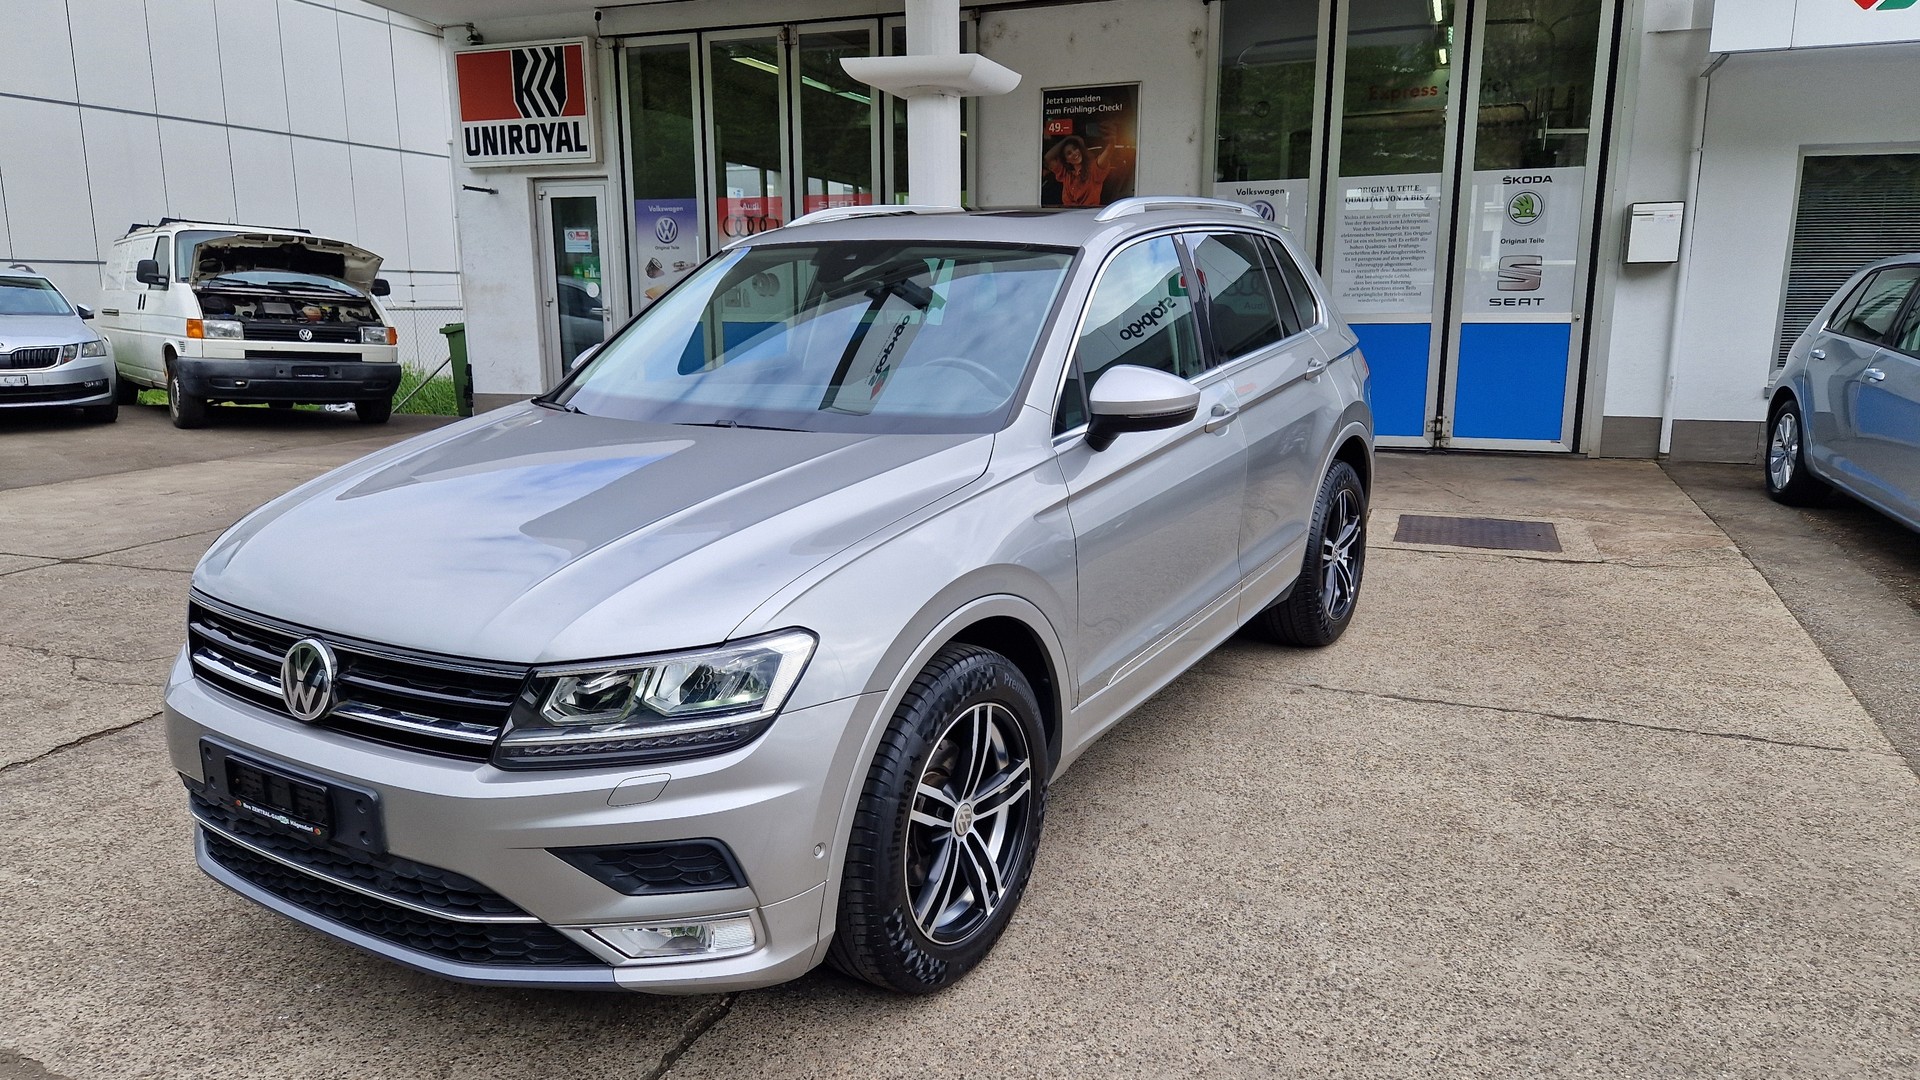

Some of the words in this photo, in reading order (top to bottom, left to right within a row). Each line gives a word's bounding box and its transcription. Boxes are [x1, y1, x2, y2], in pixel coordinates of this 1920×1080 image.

[1046, 97, 1063, 105] Jetzt
[1065, 95, 1101, 103] anmelden
[1063, 104, 1123, 115] Frühlings-Check!
[465, 121, 588, 157] UNIROYAL
[1502, 175, 1553, 185] ŠKODA
[1235, 187, 1285, 196] Volkswagen
[742, 202, 760, 210] Audi
[818, 200, 857, 208] SEAT
[648, 205, 684, 214] Volkswagen
[1488, 298, 1545, 306] SEAT
